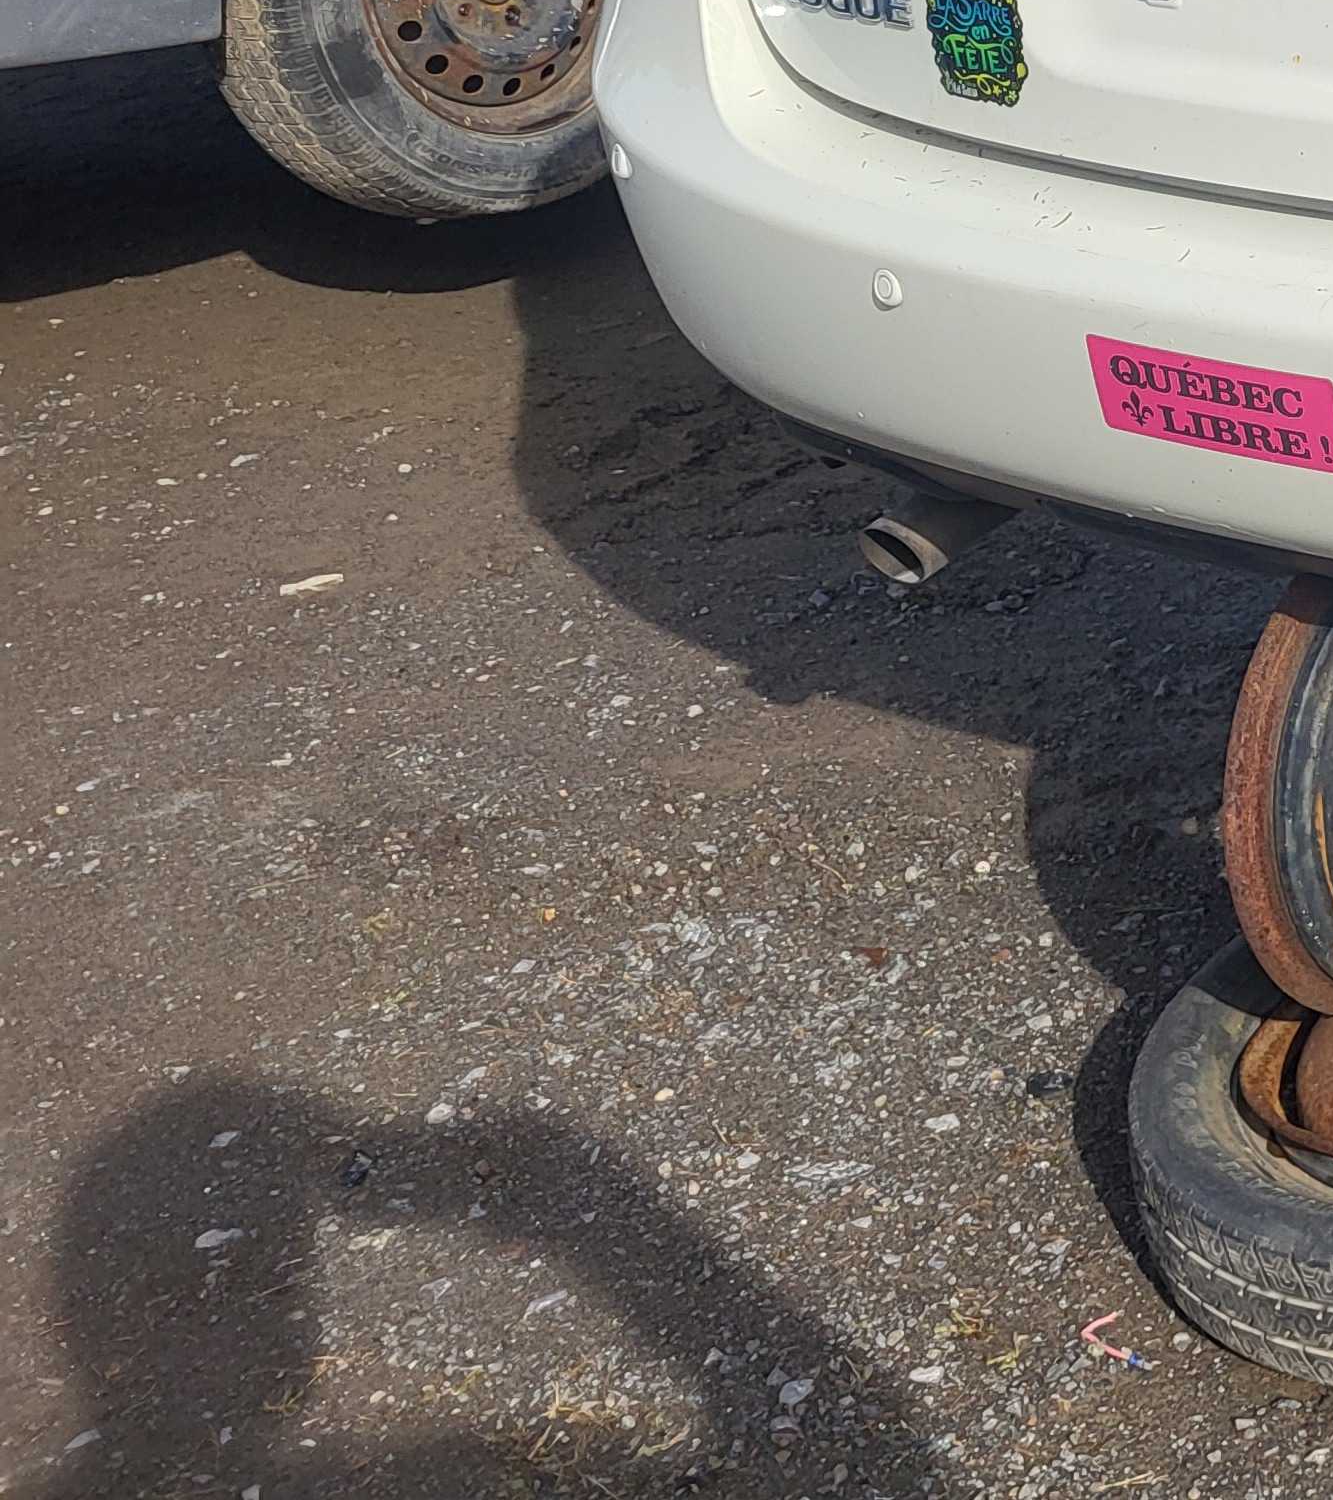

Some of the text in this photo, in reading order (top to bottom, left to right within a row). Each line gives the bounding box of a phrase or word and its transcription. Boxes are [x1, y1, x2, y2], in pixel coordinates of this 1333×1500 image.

[942, 33, 1008, 74] FÊTE
[971, 24, 990, 41] en
[1109, 353, 1305, 419] QUÉBEC
[1158, 403, 1312, 461] LIBRE
